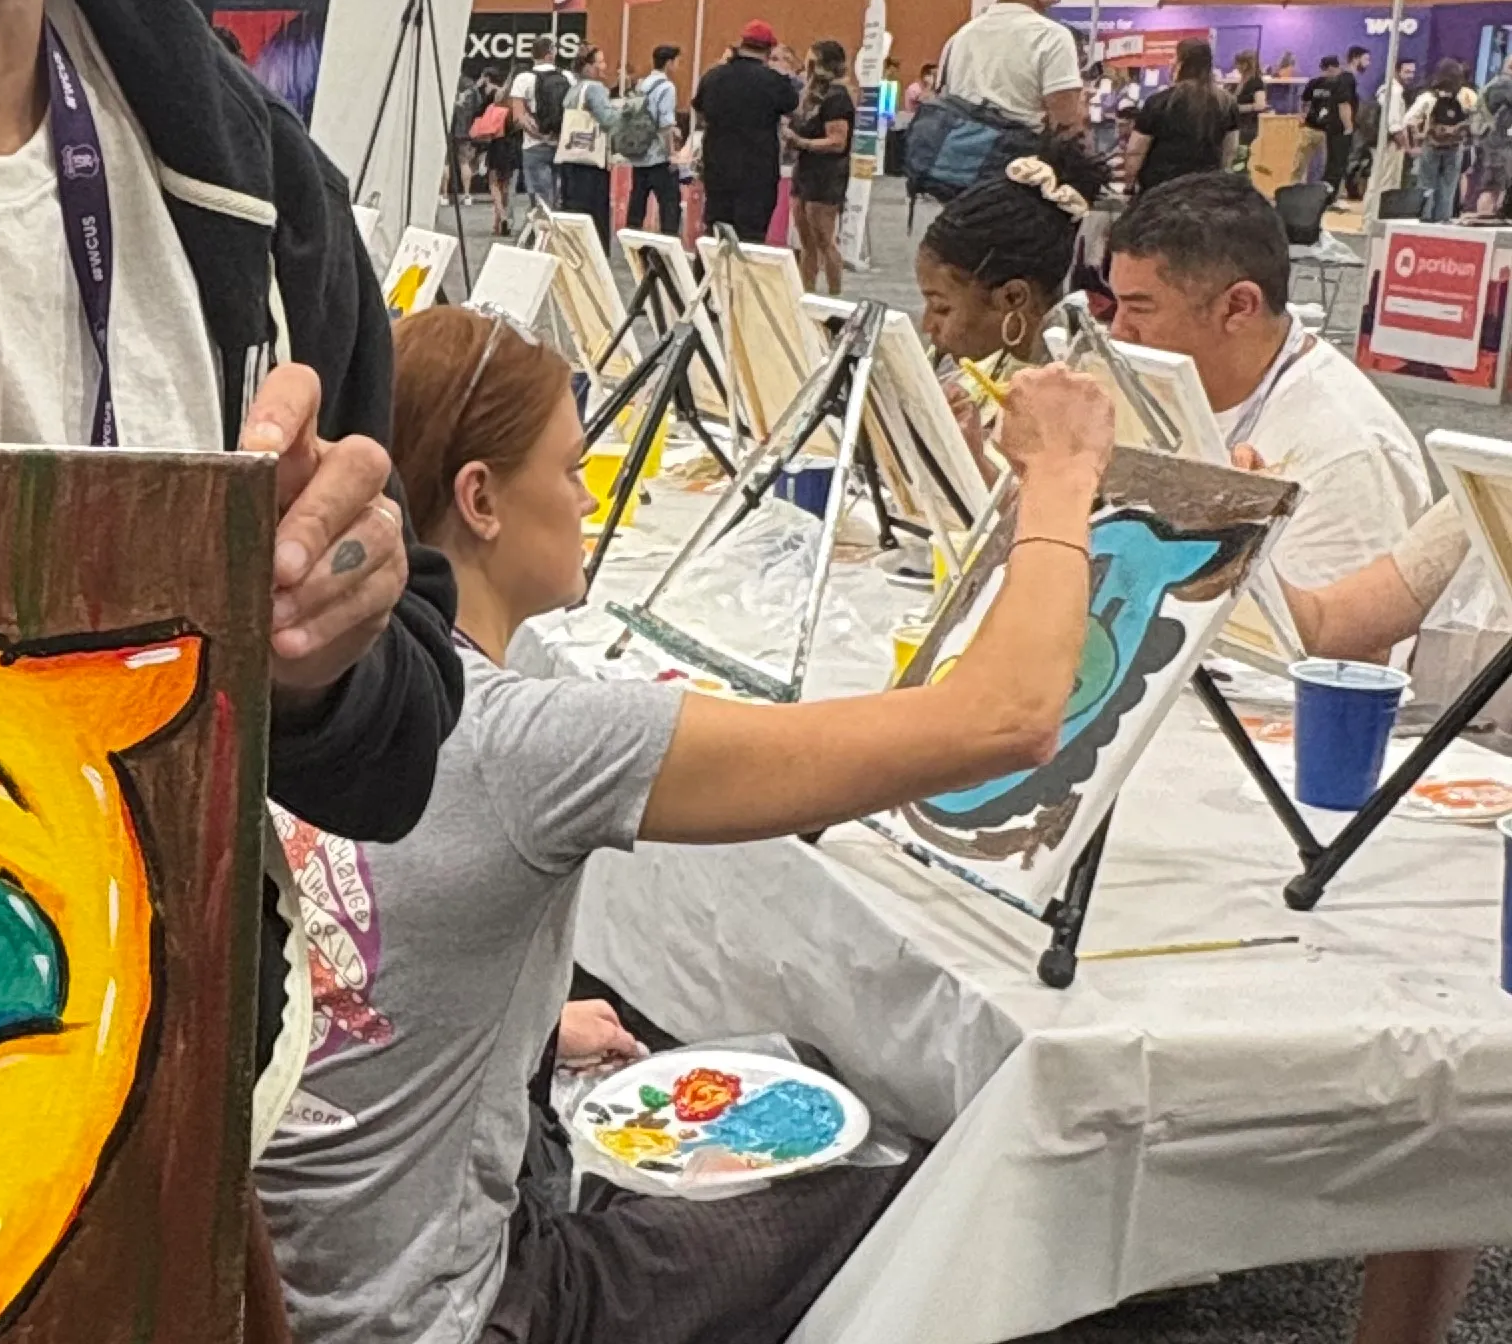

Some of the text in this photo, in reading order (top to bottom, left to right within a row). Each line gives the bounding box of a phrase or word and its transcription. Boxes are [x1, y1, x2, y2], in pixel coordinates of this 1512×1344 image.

[467, 32, 581, 59] XCES
[81, 214, 105, 283] #WCUS
[1415, 255, 1477, 279] porkbun
